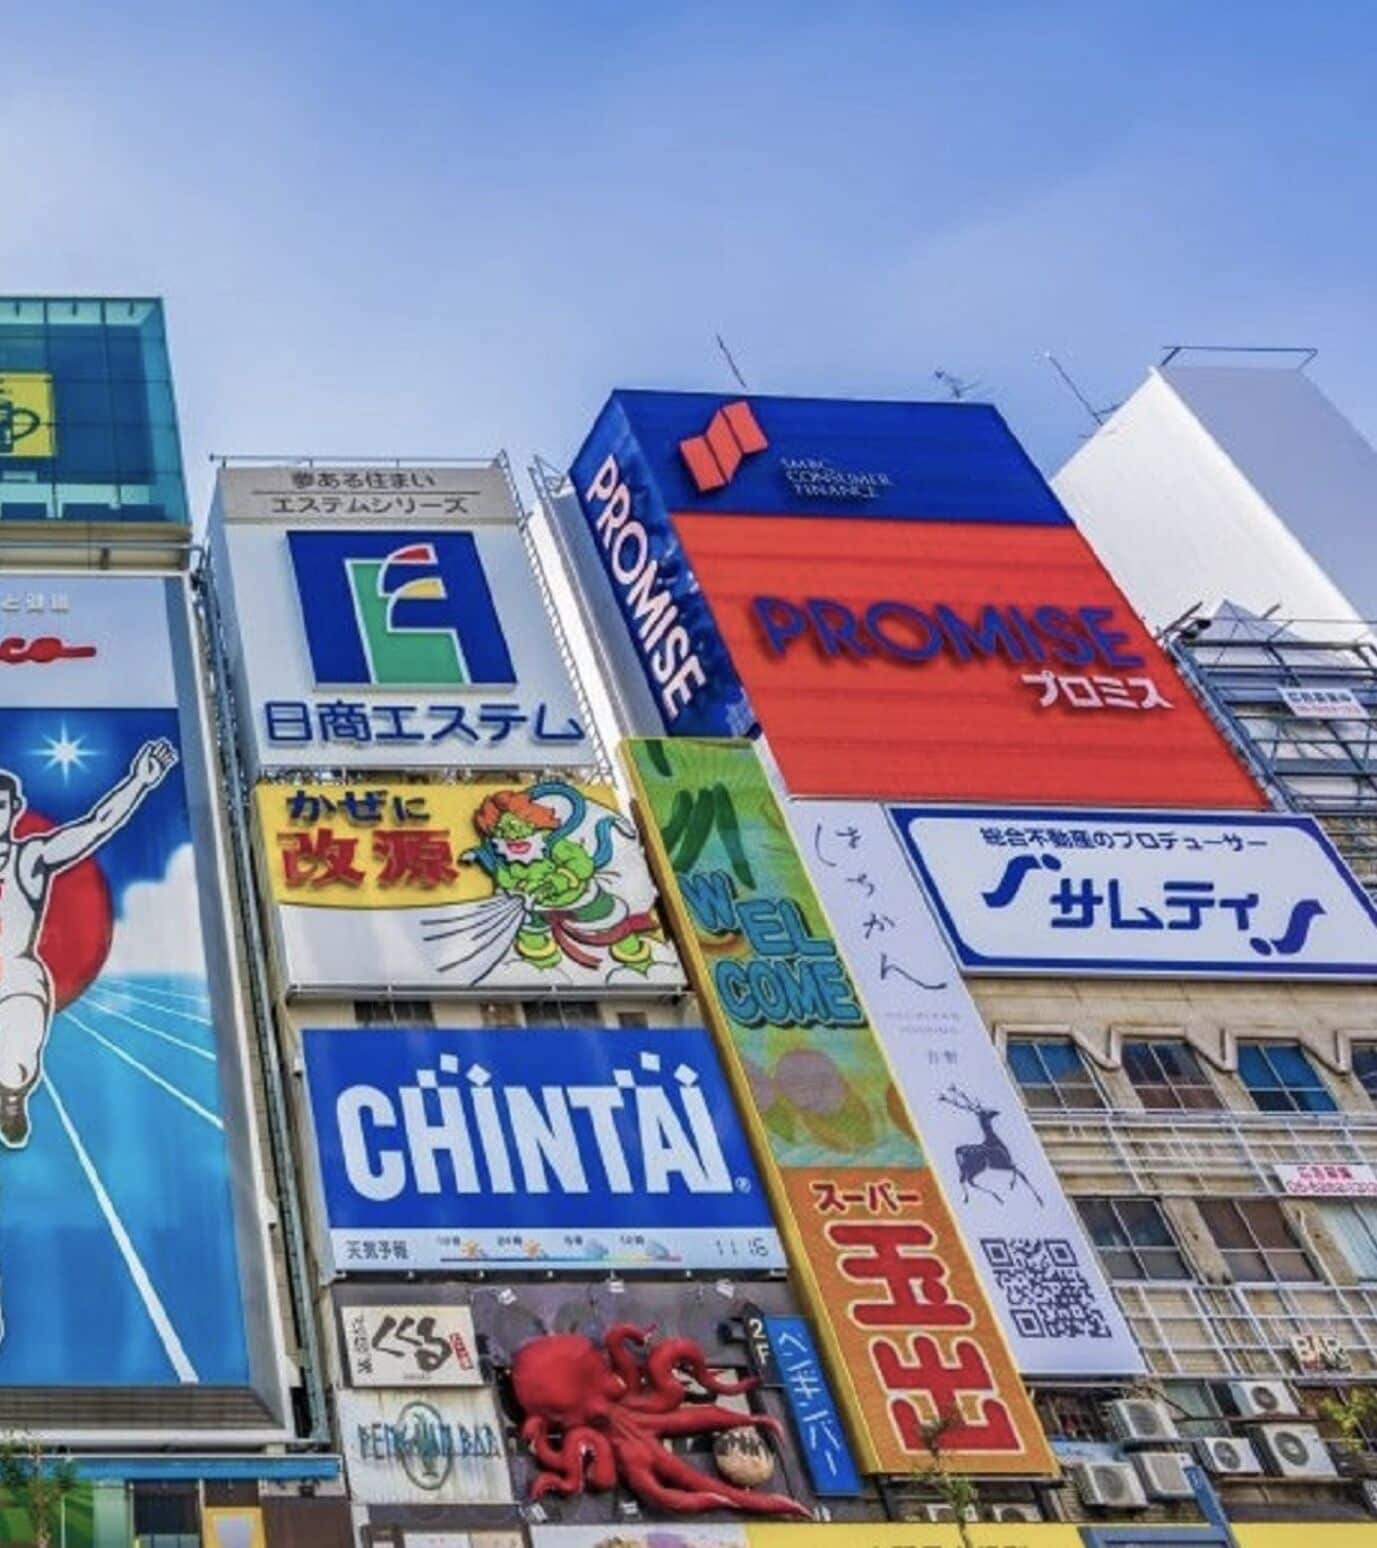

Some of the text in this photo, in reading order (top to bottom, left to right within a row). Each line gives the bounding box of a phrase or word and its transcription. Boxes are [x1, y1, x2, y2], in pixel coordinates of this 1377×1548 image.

[291, 472, 435, 489] 夢ある住まい
[272, 498, 469, 515] エステムシリーズ
[586, 455, 707, 716] PROMISE
[752, 596, 1144, 667] PROMISE
[1022, 673, 1173, 709] プロミス
[265, 700, 586, 743] 日商エステム
[287, 789, 430, 822] かぜに
[276, 828, 460, 889] 改源
[980, 828, 1267, 851] 総合不動産のプロデューサー
[1050, 878, 1258, 931] サムティ
[336, 1052, 734, 1201] CHINTAI
[811, 1182, 921, 1213] スーパー
[372, 1315, 452, 1372] くくる
[749, 1319, 770, 1365] 2F
[825, 1222, 1024, 1454] 玉出
